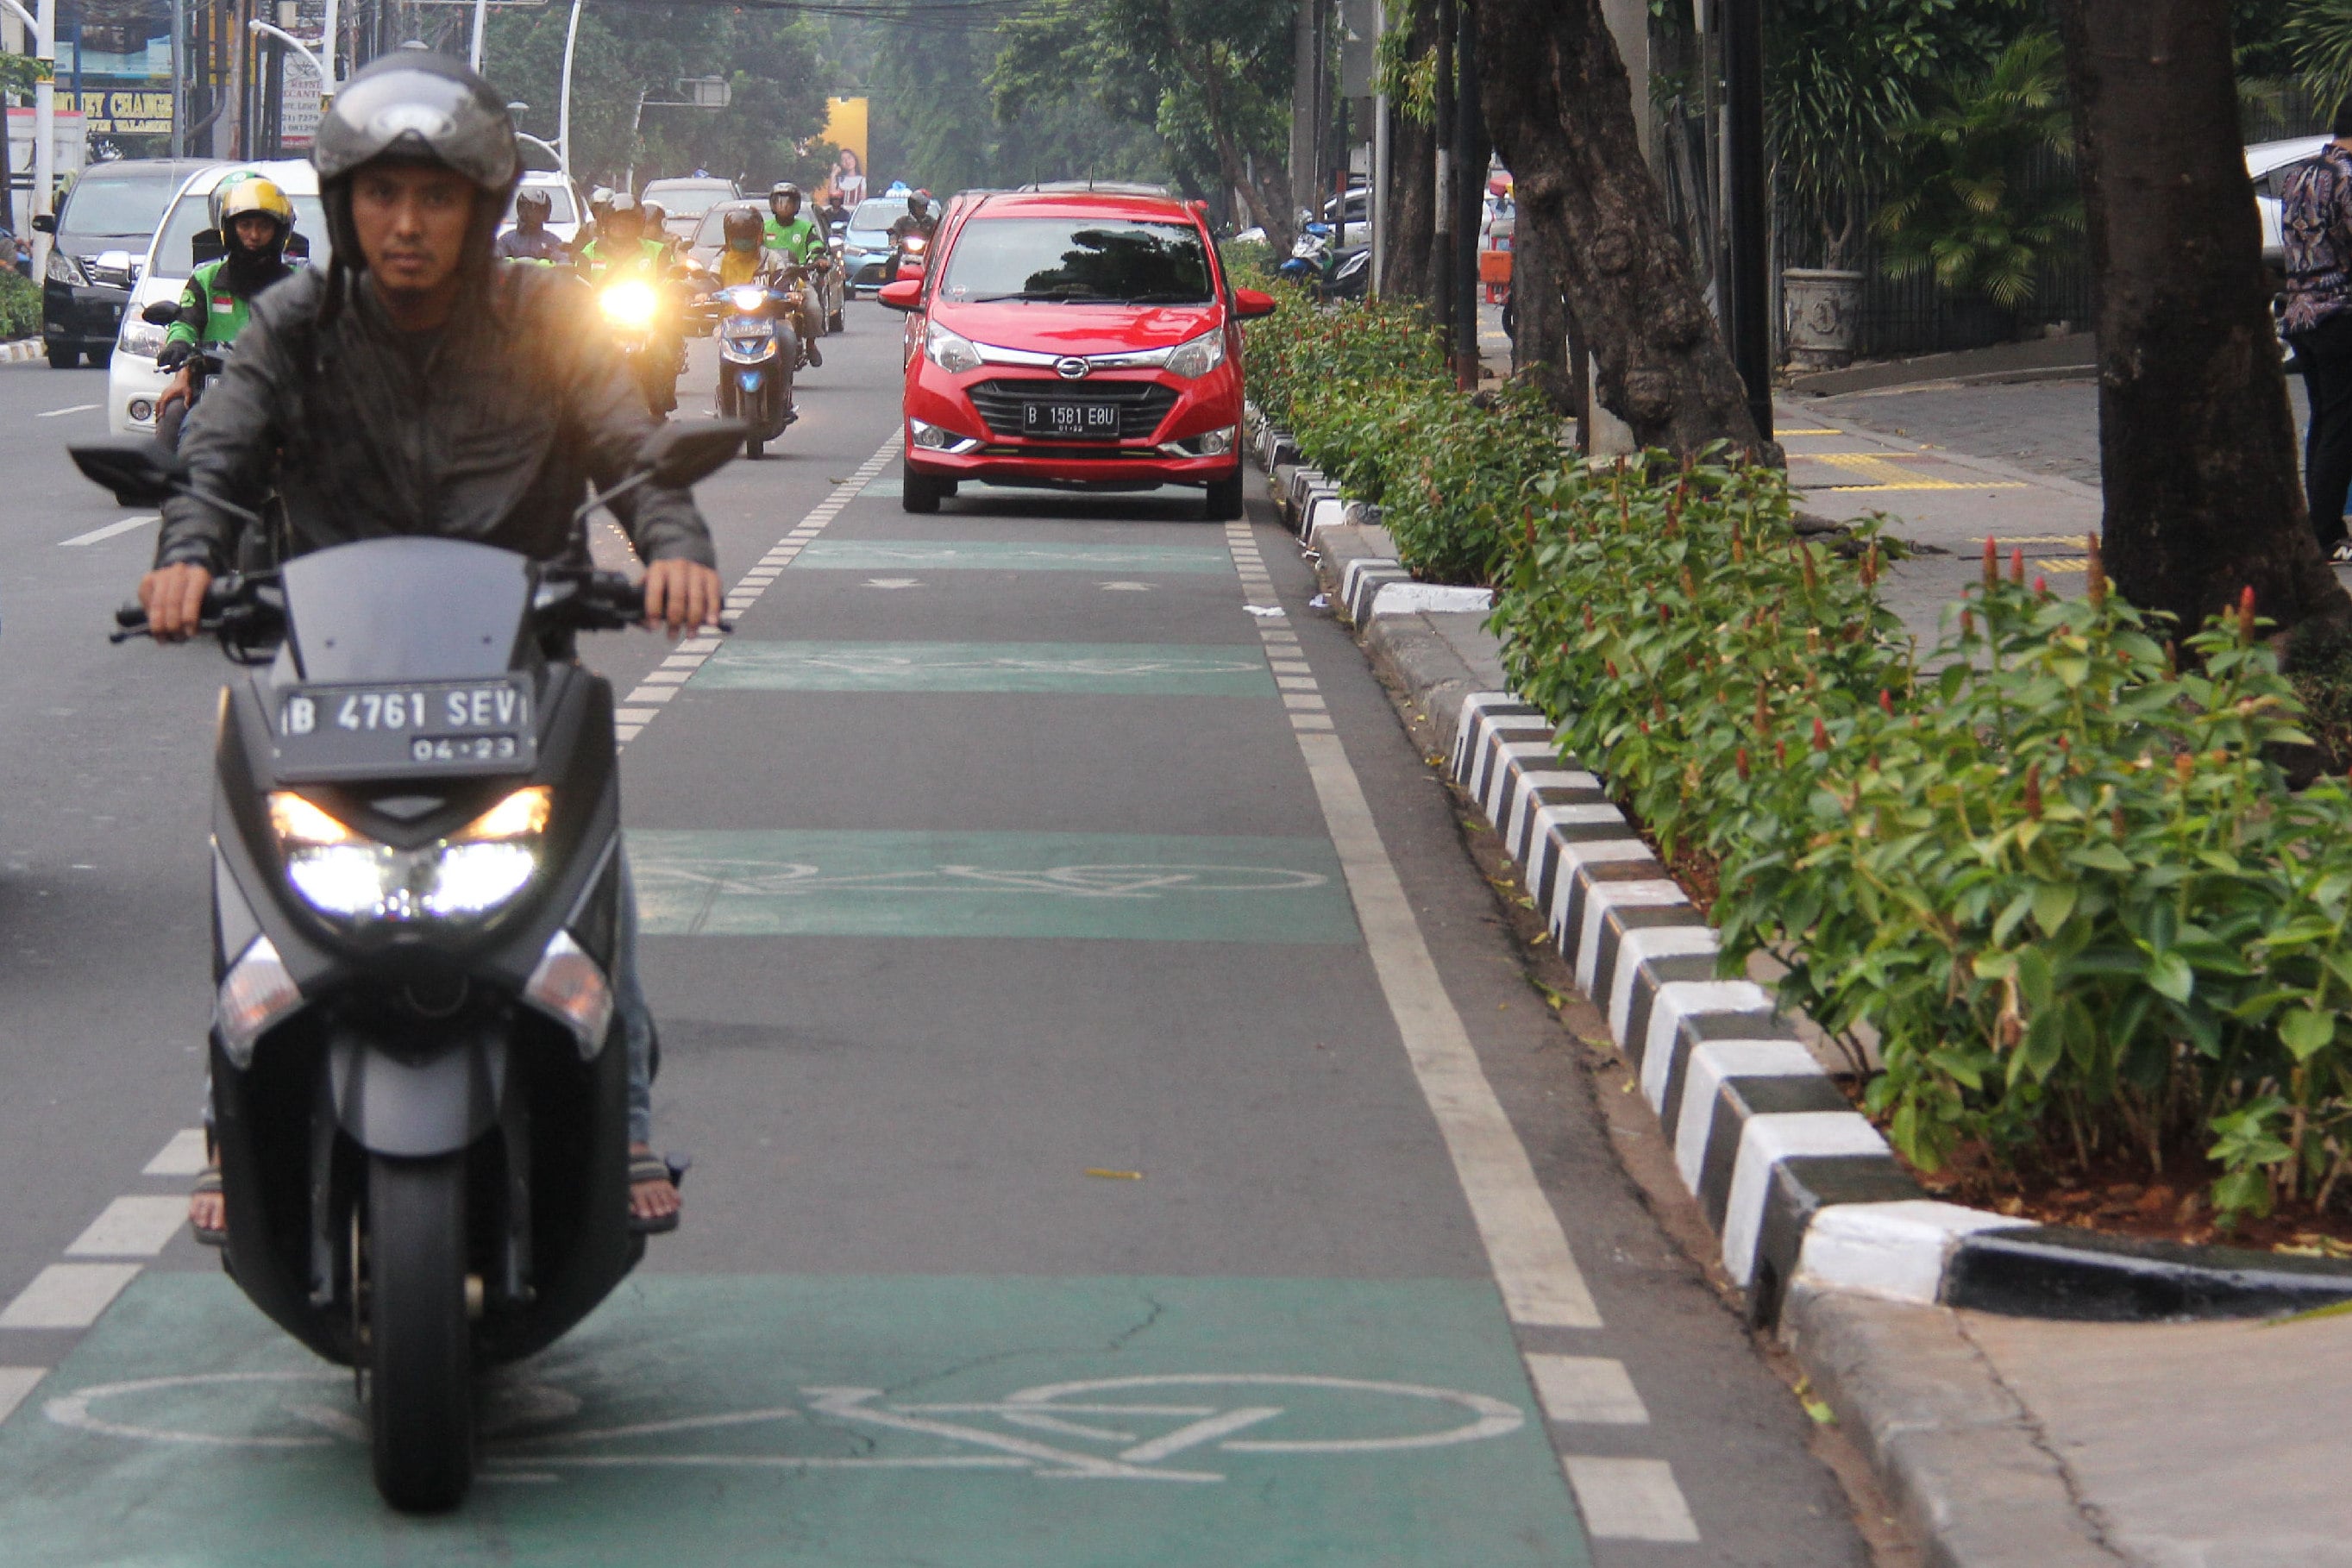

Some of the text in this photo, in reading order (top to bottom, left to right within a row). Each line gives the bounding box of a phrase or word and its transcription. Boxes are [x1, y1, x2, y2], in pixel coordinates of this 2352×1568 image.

[1029, 406, 1038, 424] B
[1051, 407, 1082, 424] 1581
[290, 688, 516, 735] B 4761 SEV
